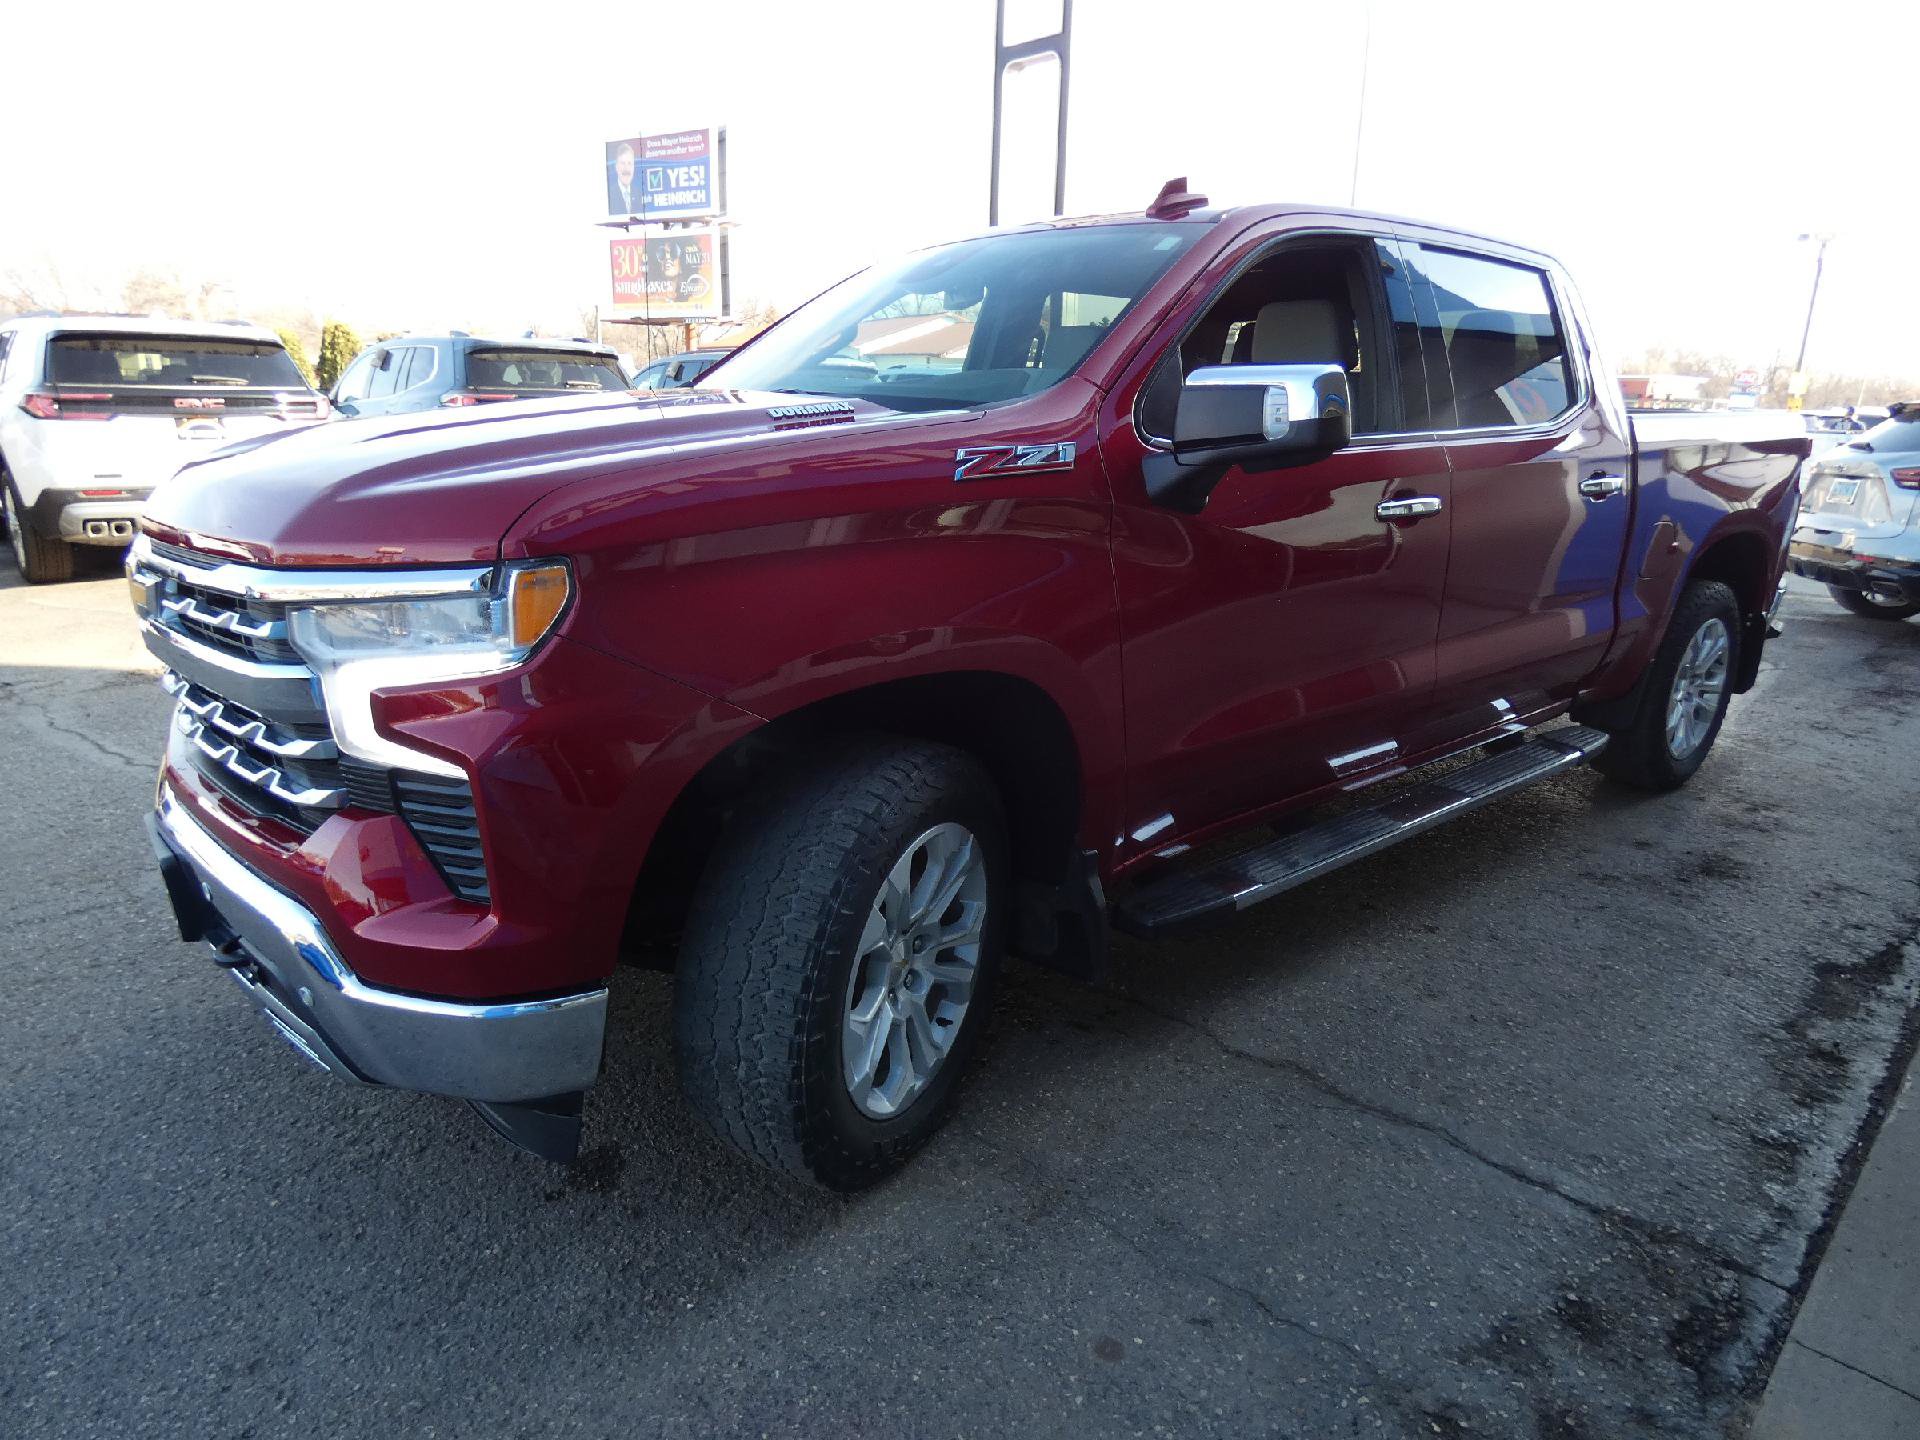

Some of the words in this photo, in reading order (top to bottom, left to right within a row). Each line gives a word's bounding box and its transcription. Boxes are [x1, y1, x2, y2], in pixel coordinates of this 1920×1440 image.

[667, 166, 705, 188] YES!
[653, 190, 706, 206] HEINRICH
[685, 252, 700, 265] MAY
[767, 402, 855, 420] DURAMAX
[954, 441, 1077, 481] Z71
